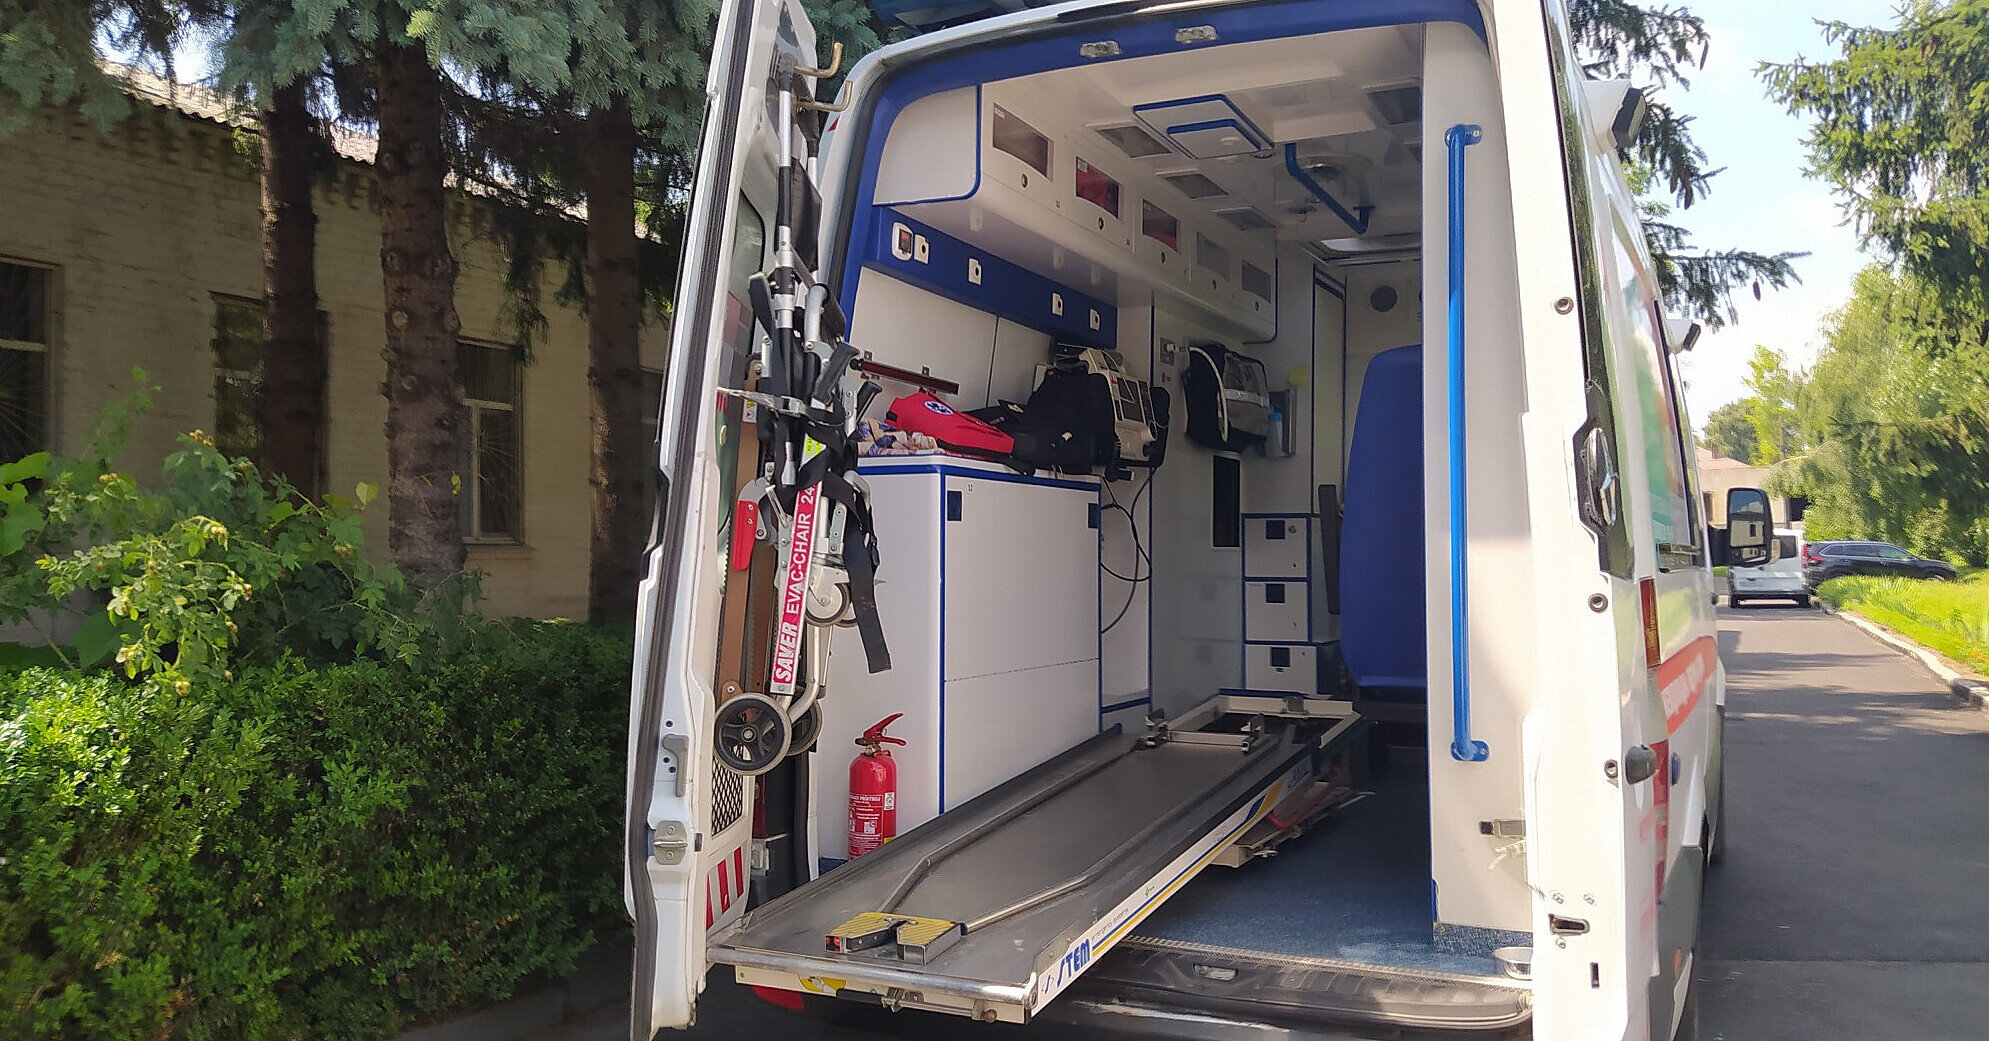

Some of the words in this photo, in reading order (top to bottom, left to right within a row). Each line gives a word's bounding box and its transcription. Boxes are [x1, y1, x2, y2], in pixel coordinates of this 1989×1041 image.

[801, 484, 815, 505] 24
[786, 513, 812, 615] EVAC-CHAIR
[775, 621, 798, 682] SAVER
[1057, 938, 1090, 988] STEM
